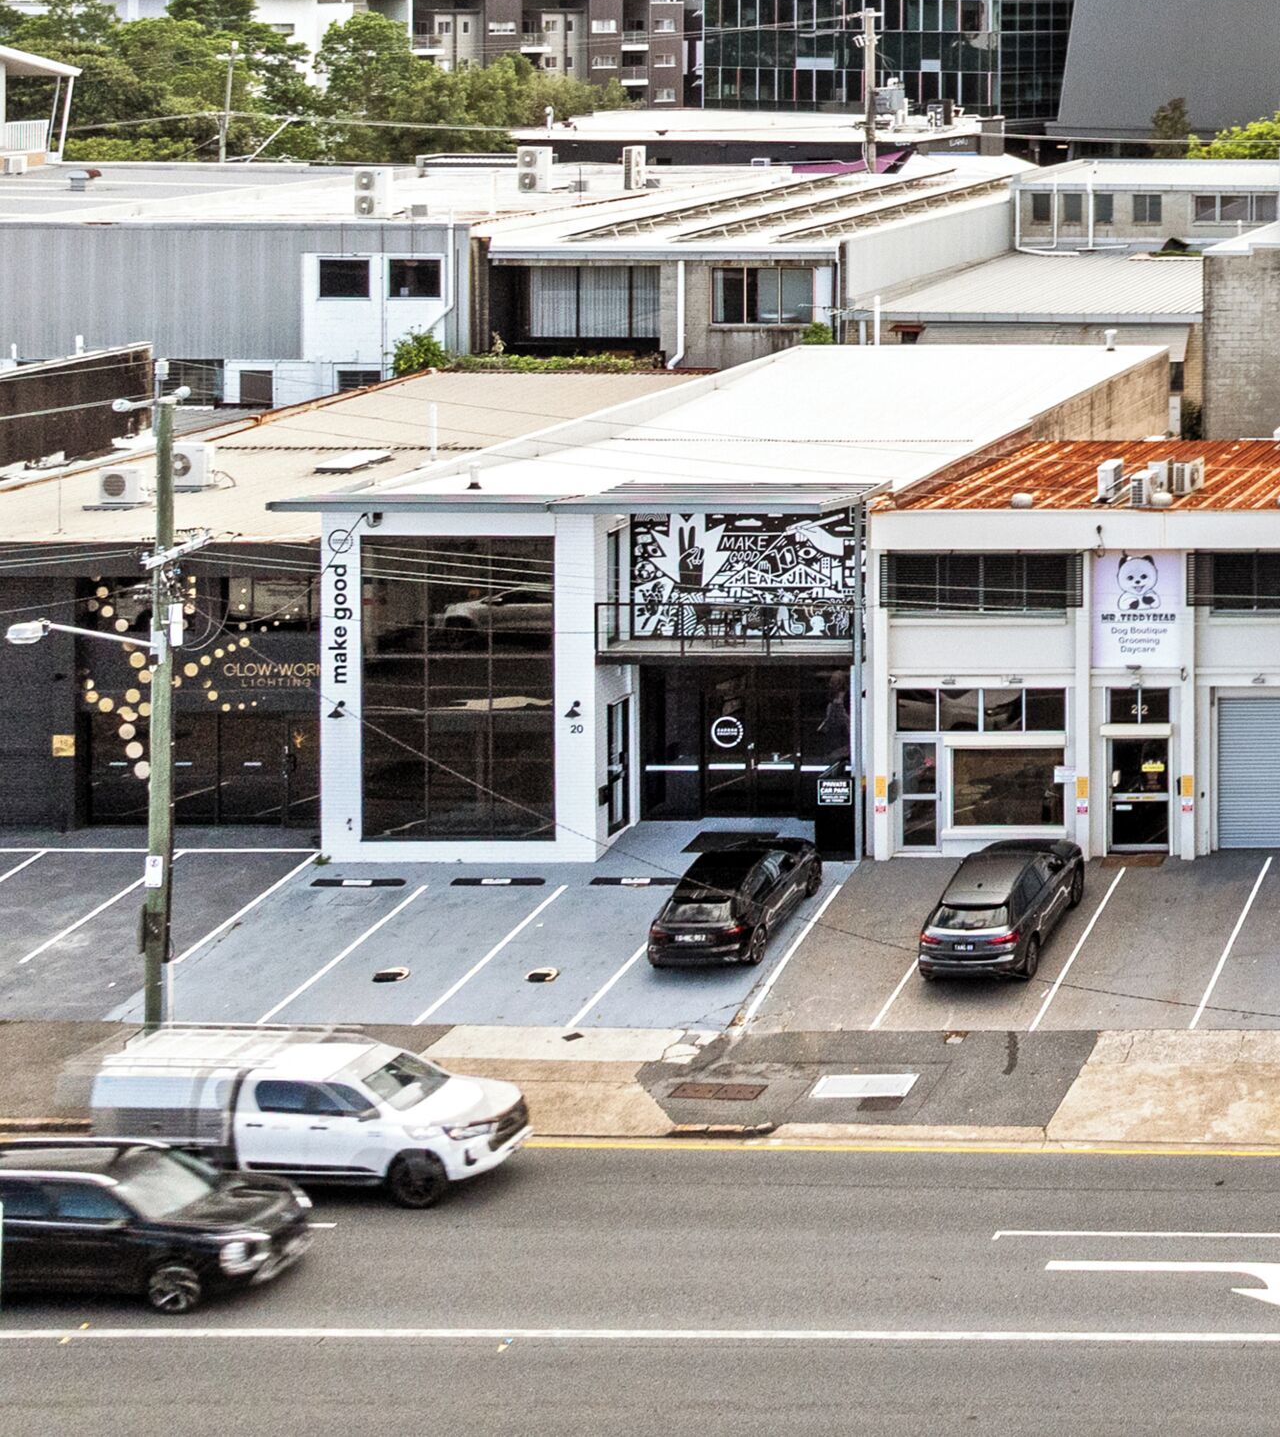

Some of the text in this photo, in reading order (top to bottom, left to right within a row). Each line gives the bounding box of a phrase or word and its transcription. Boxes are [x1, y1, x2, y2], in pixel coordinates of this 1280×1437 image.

[720, 535, 769, 550] MAKE
[729, 551, 760, 562] GOOD
[328, 564, 353, 620] good
[1111, 627, 1168, 636] Dog Boutique
[1118, 637, 1160, 645] Grooming
[328, 626, 347, 684] make
[1120, 646, 1156, 654] Daycare
[241, 677, 311, 687] LIGHTING
[571, 724, 584, 734] 20
